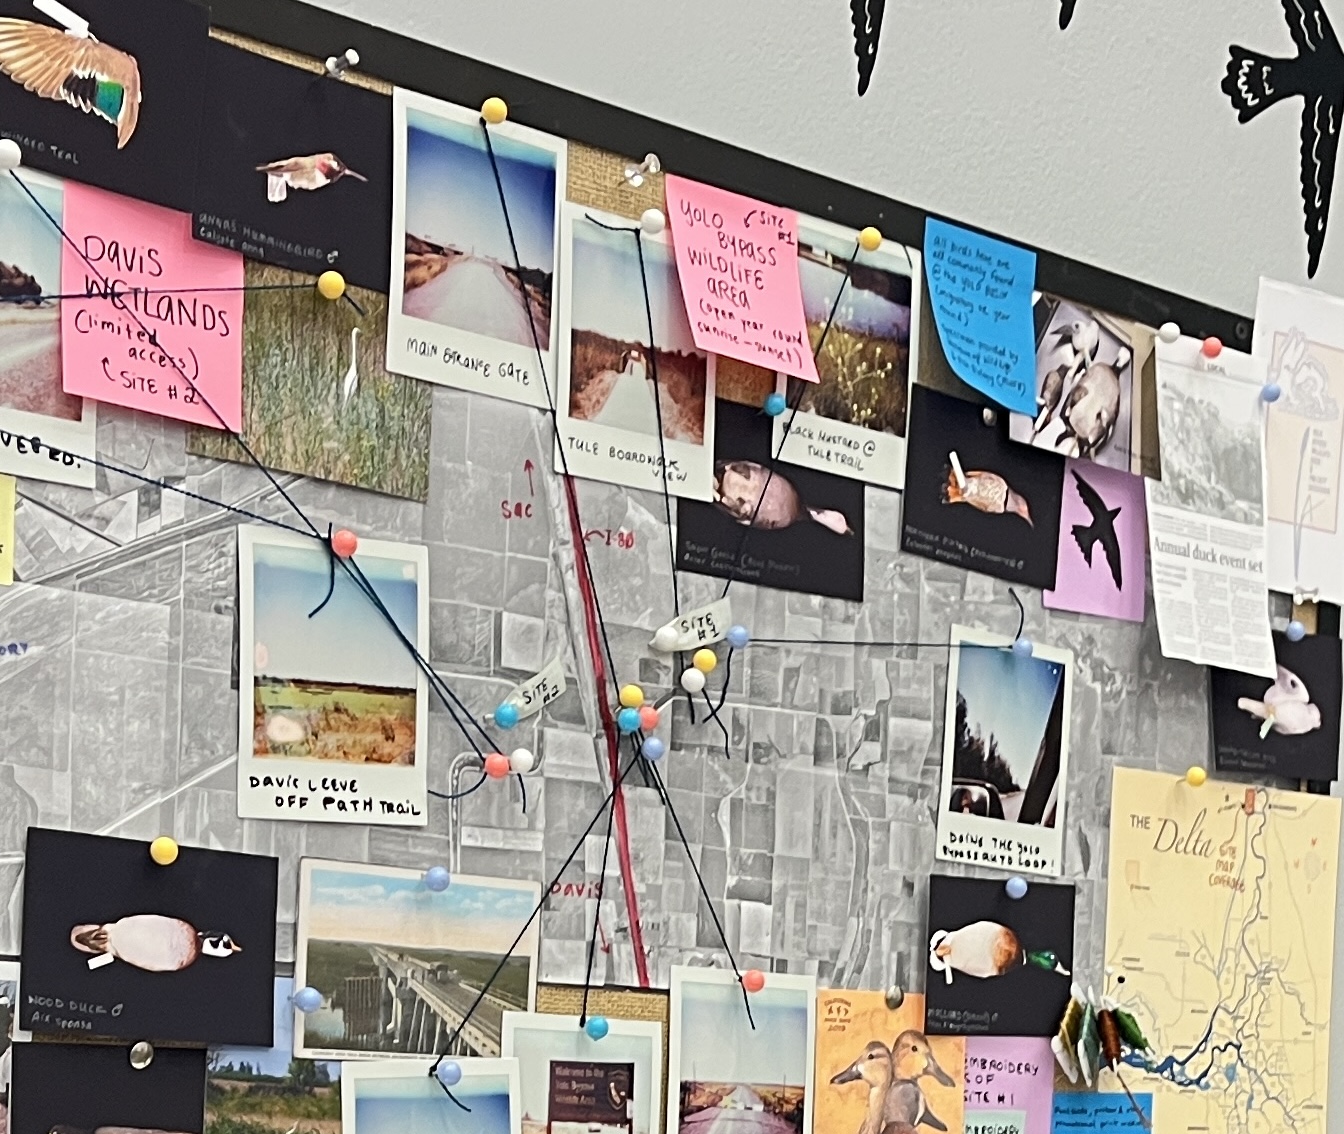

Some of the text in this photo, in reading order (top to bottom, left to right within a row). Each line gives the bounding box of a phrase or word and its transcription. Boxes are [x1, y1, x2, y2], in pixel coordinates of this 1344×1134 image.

[681, 199, 723, 228] YOLO
[75, 309, 157, 346] (limited
[129, 347, 199, 380] access)
[1154, 537, 1263, 573] Annual duck event set
[275, 795, 308, 809] OFF
[1130, 807, 1217, 858] THE Delta
